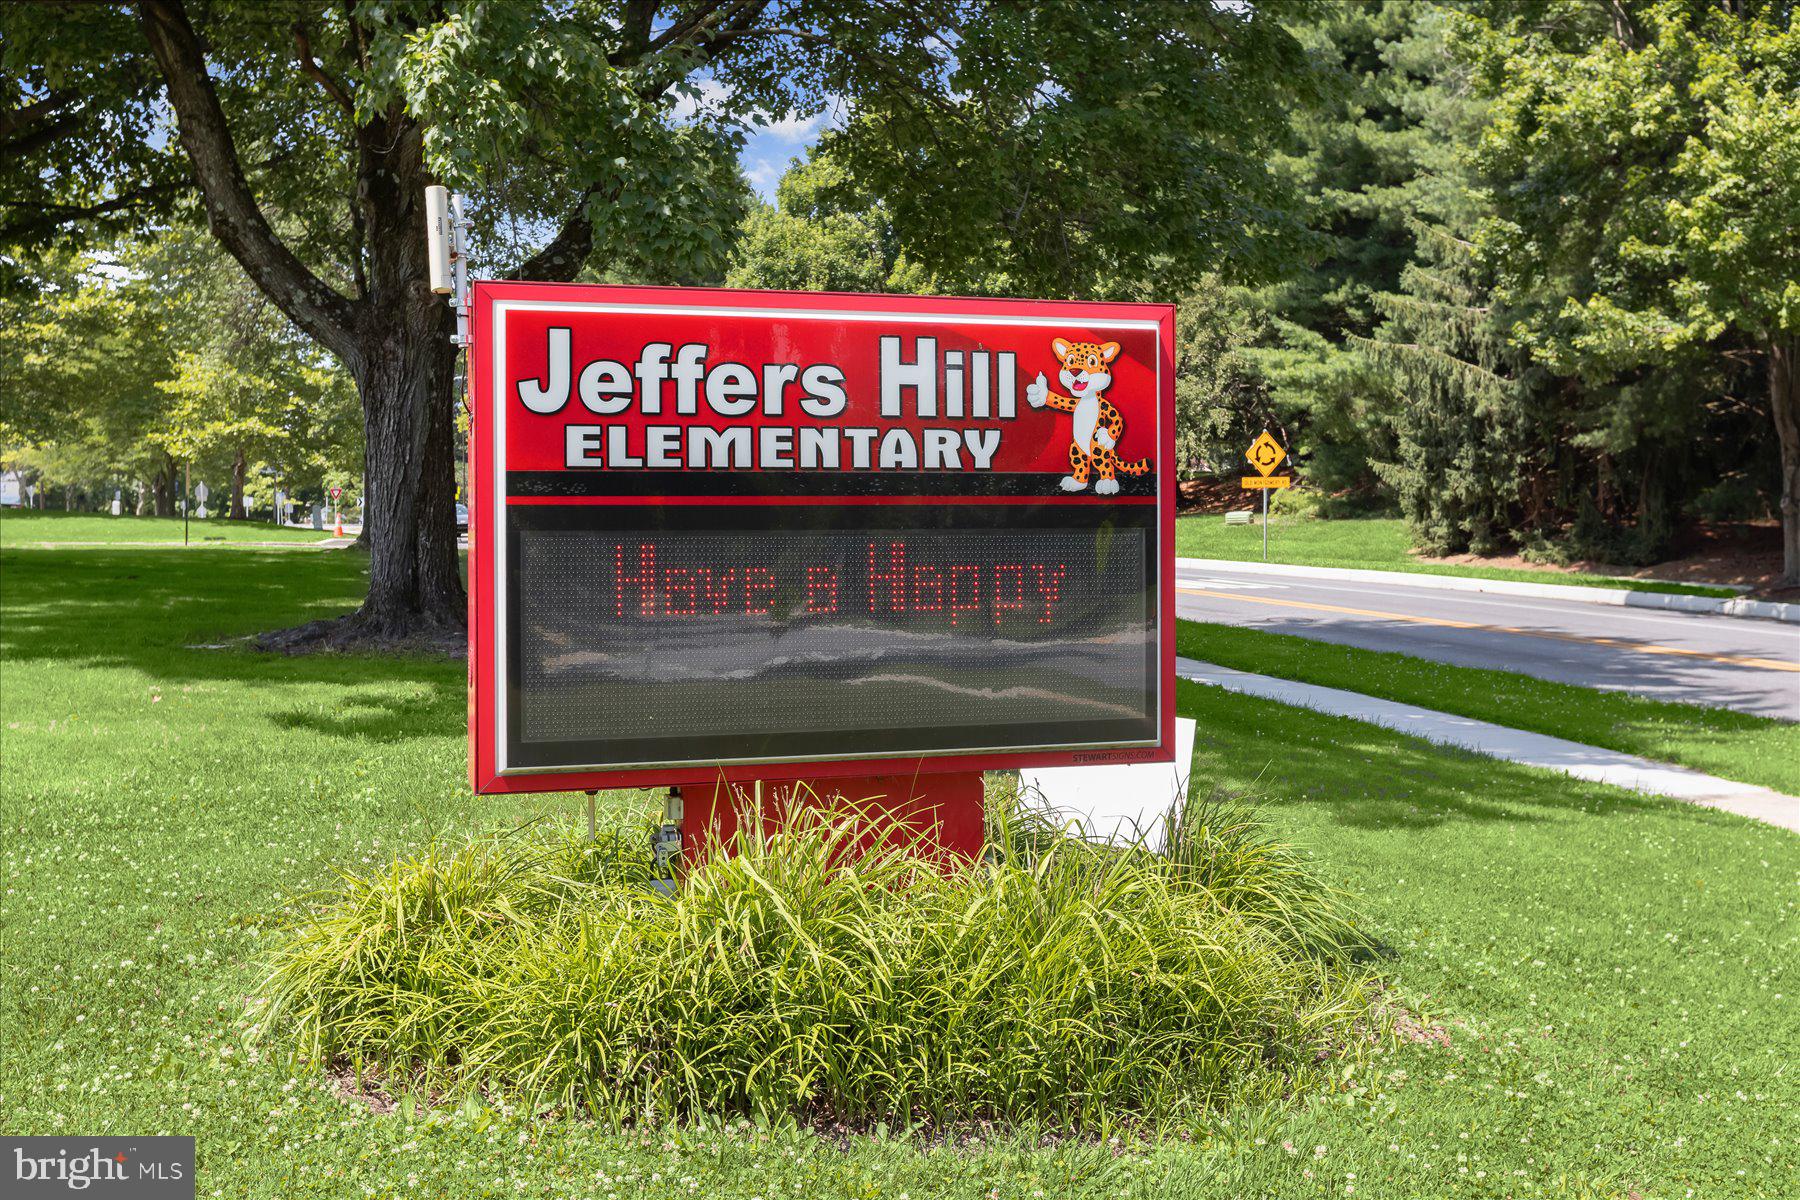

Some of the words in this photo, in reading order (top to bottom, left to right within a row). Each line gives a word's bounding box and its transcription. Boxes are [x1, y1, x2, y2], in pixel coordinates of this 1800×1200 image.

[516, 327, 847, 417] Jeffers
[880, 335, 1017, 419] Hill
[564, 424, 1002, 471] ELEMENTARY
[616, 544, 775, 616] Have
[807, 567, 837, 612] a
[869, 543, 1065, 625] Happy
[1072, 751, 1155, 762] STEWARTSIGNS.COM
